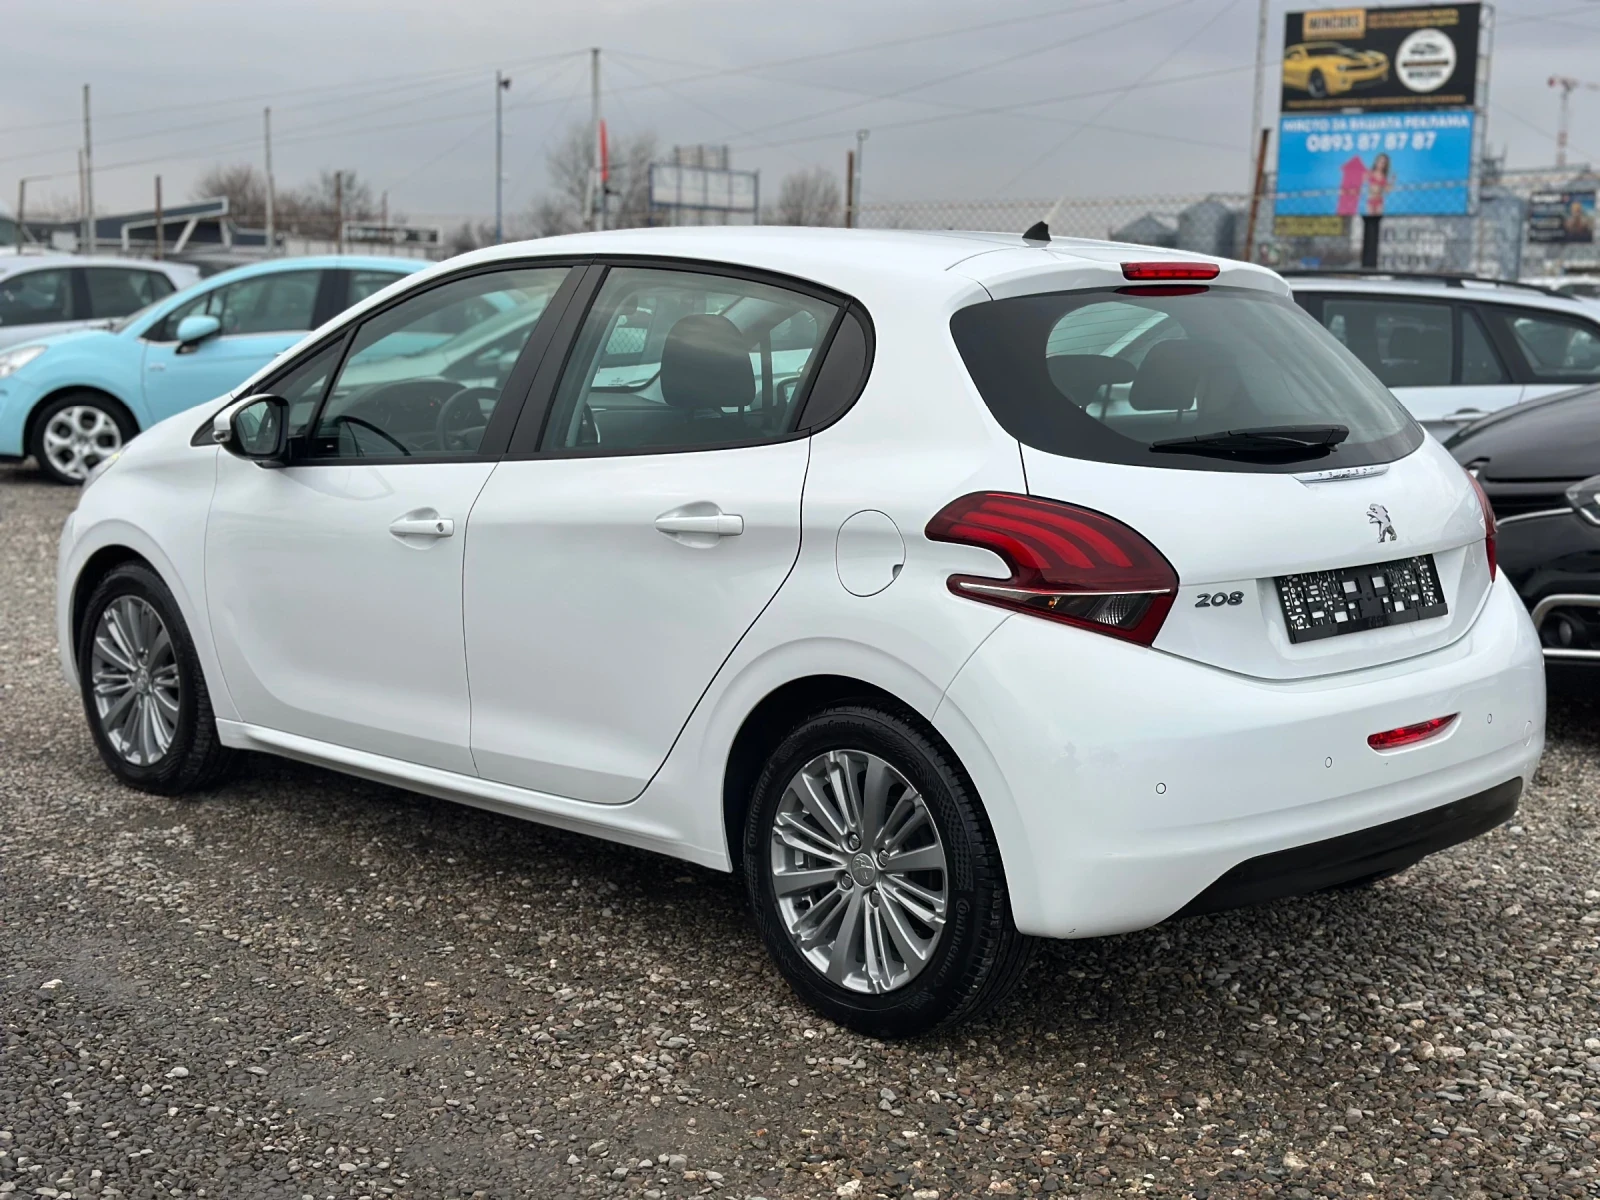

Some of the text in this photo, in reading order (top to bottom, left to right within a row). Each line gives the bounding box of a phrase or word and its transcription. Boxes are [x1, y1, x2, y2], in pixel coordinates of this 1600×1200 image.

[1283, 115, 1470, 132] МЯСТО ЗА ВАШАТА РЕКЛАМА
[1305, 131, 1437, 153] 0893 87 87 87
[1194, 590, 1245, 608] 208
